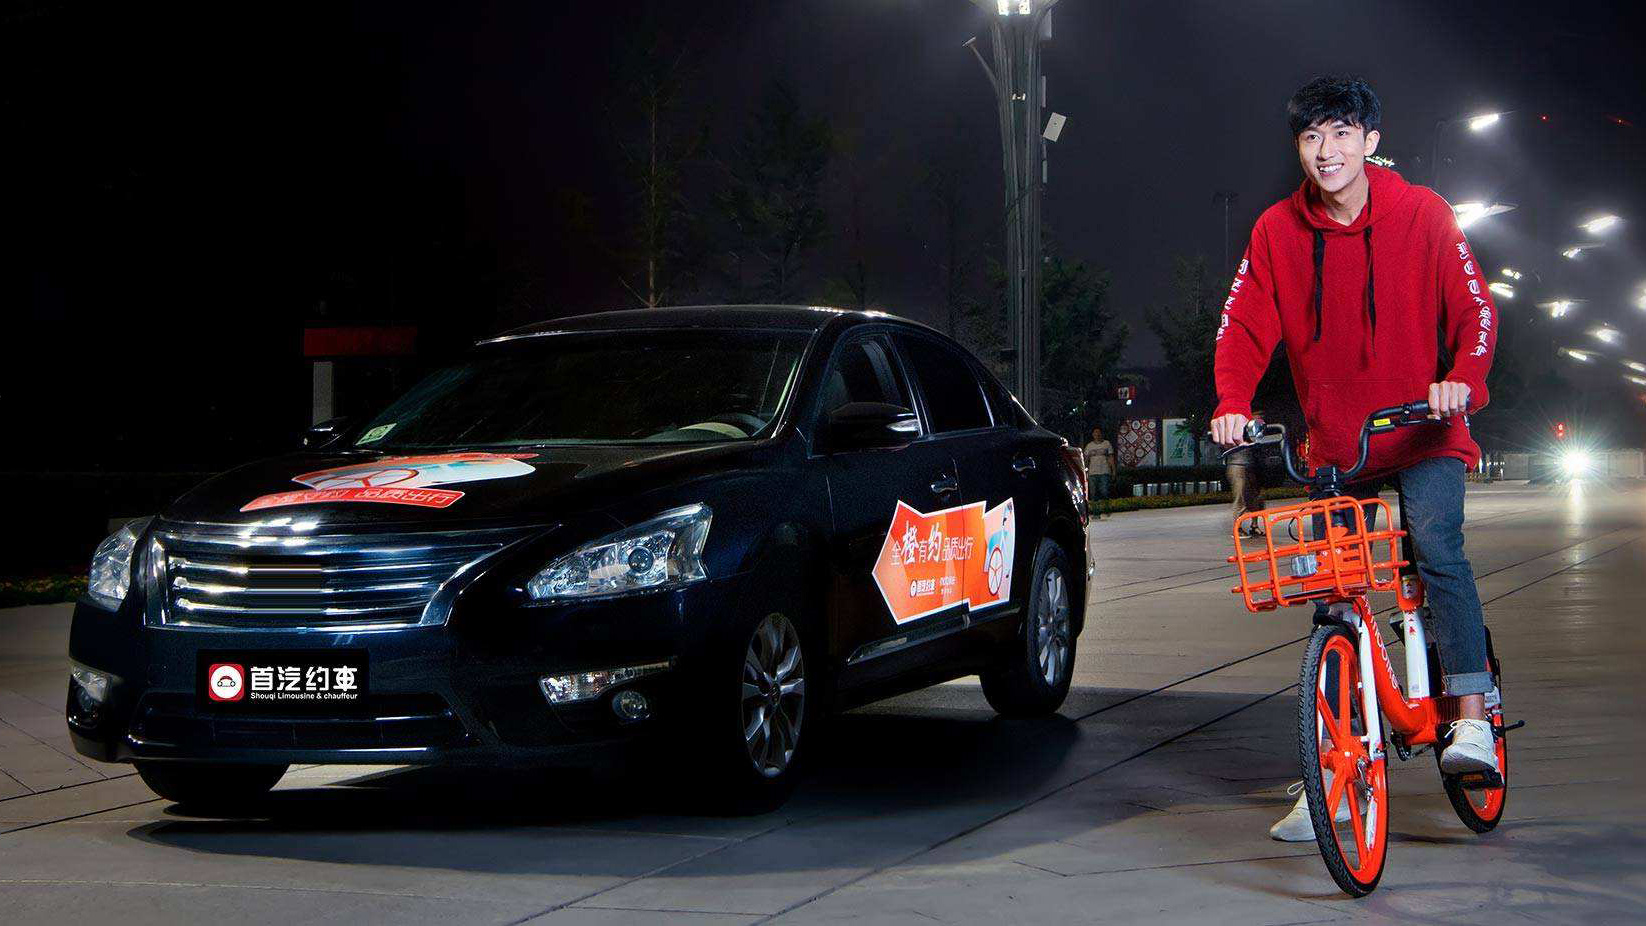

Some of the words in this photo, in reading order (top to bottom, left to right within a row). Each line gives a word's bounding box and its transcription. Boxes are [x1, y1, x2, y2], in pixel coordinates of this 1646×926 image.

[250, 692, 276, 701] Shouqi
[277, 692, 315, 700] Limousine
[316, 692, 322, 700] &
[323, 692, 358, 700] chauffeur
